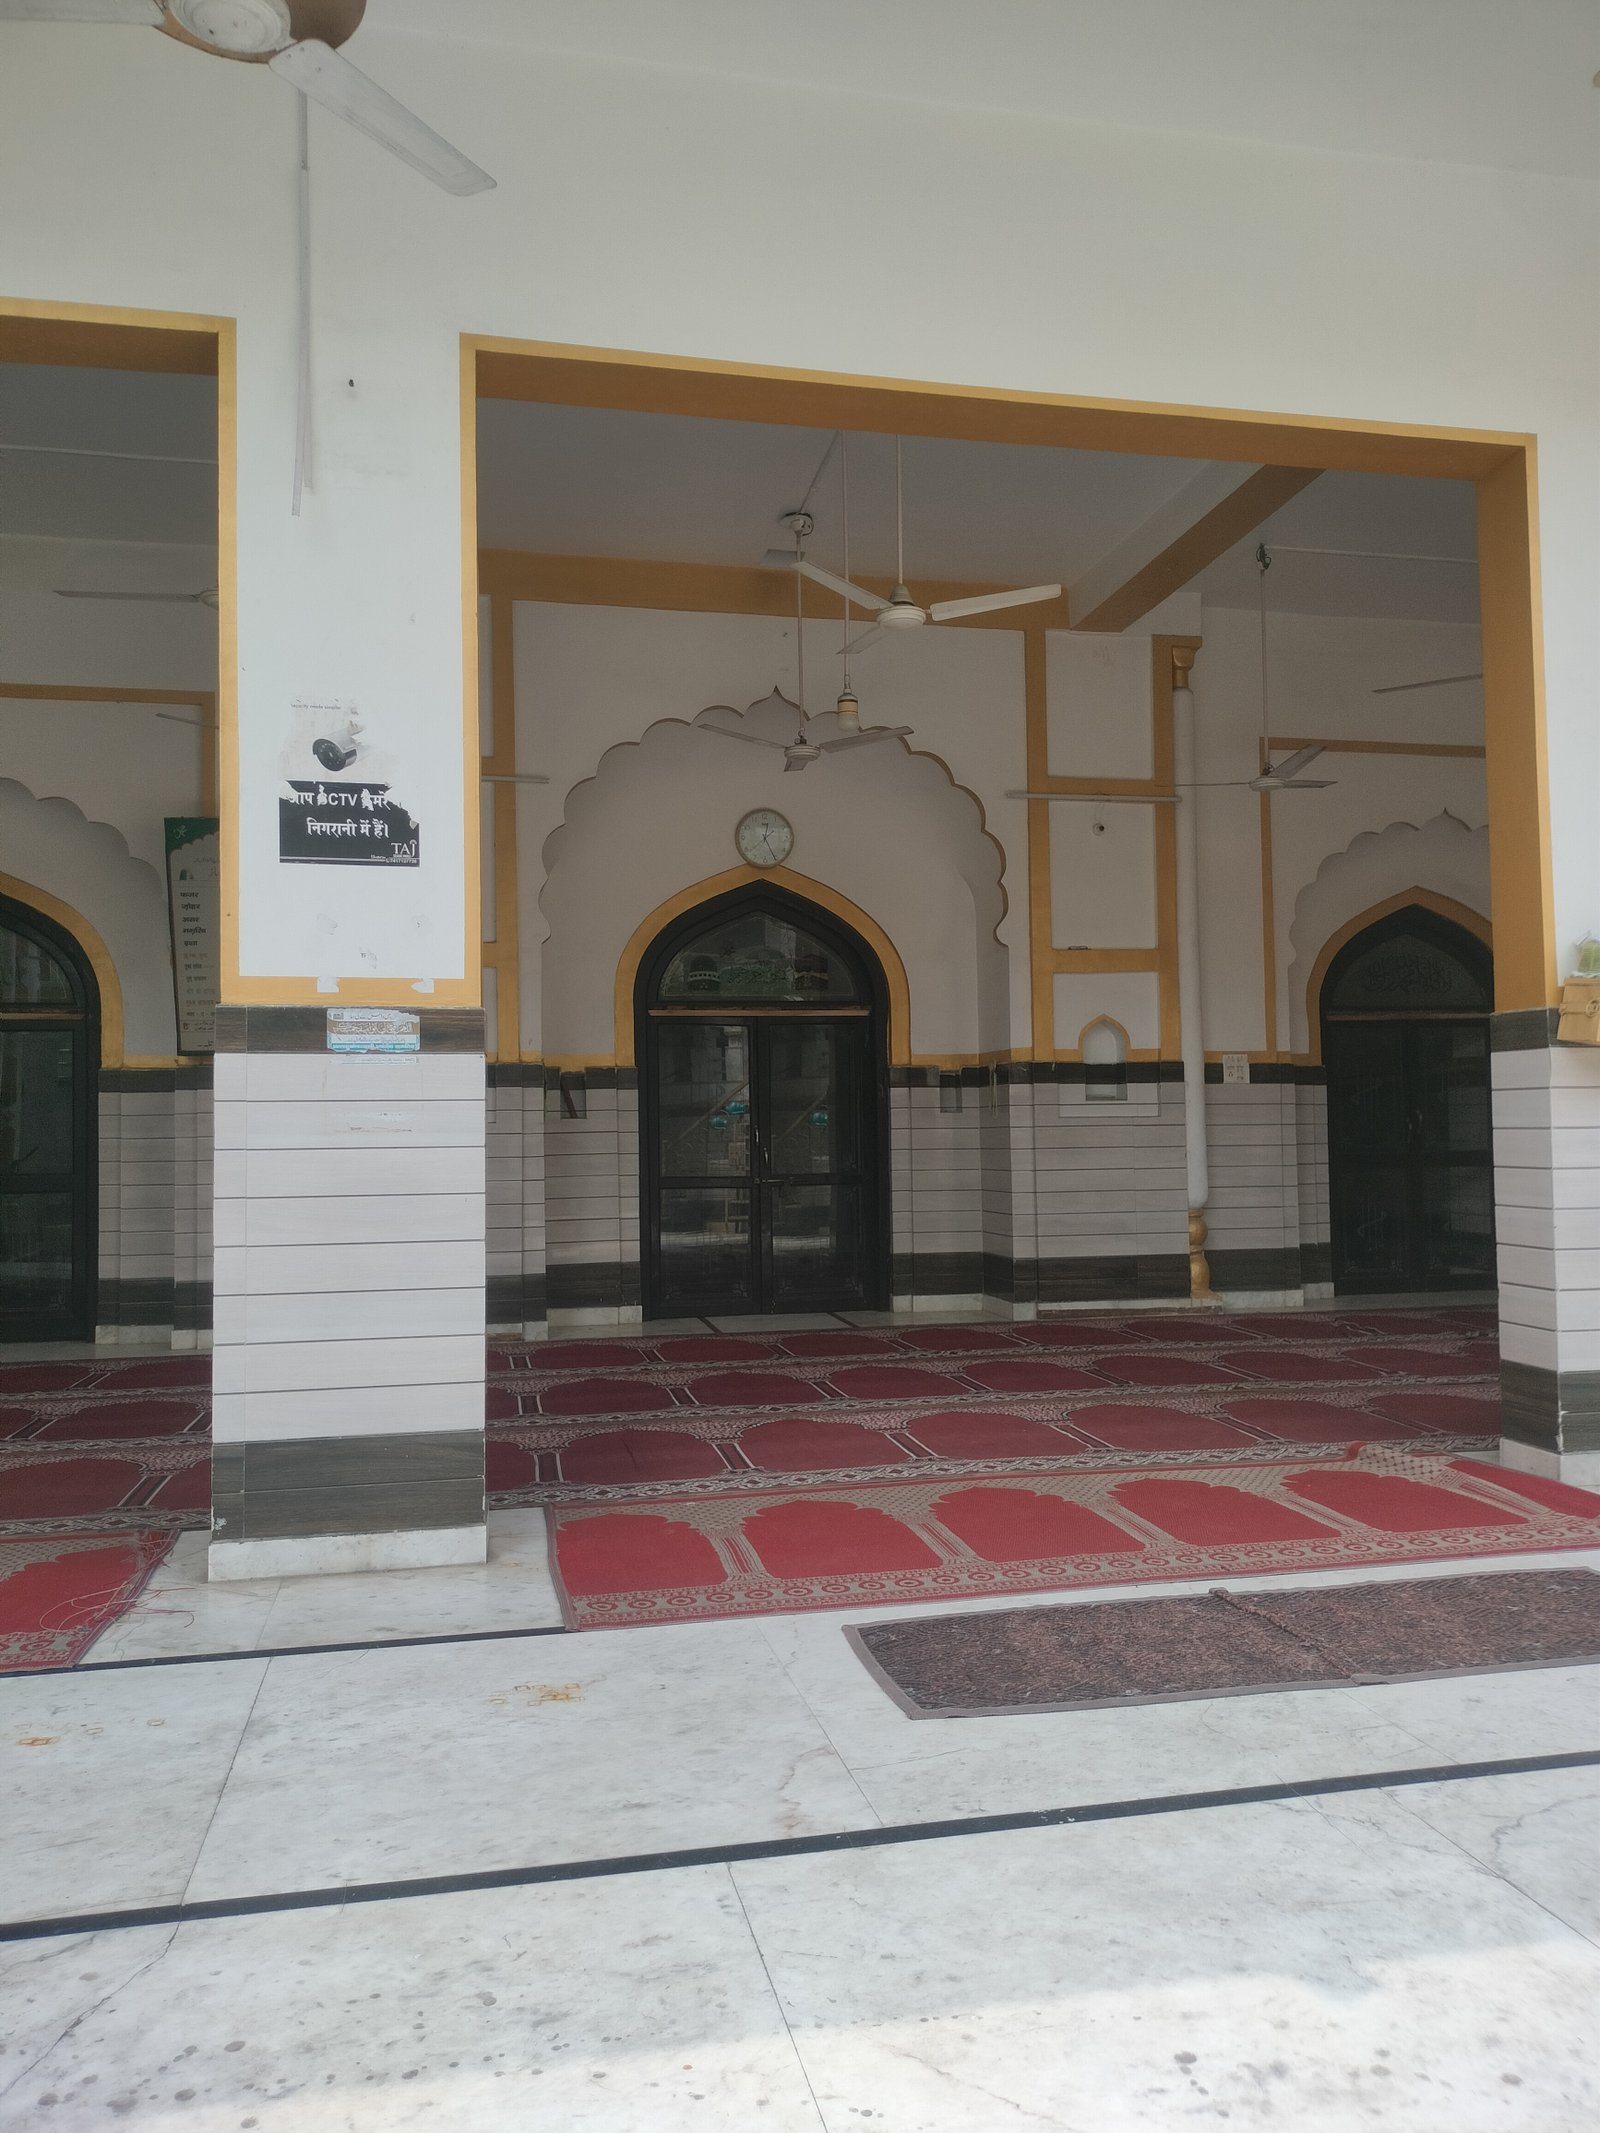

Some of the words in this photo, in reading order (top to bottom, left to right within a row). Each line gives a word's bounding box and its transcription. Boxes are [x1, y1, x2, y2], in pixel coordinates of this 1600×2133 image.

[306, 817, 357, 838] निगरानी
[360, 819, 371, 838] में
[391, 839, 417, 857] TAJ
